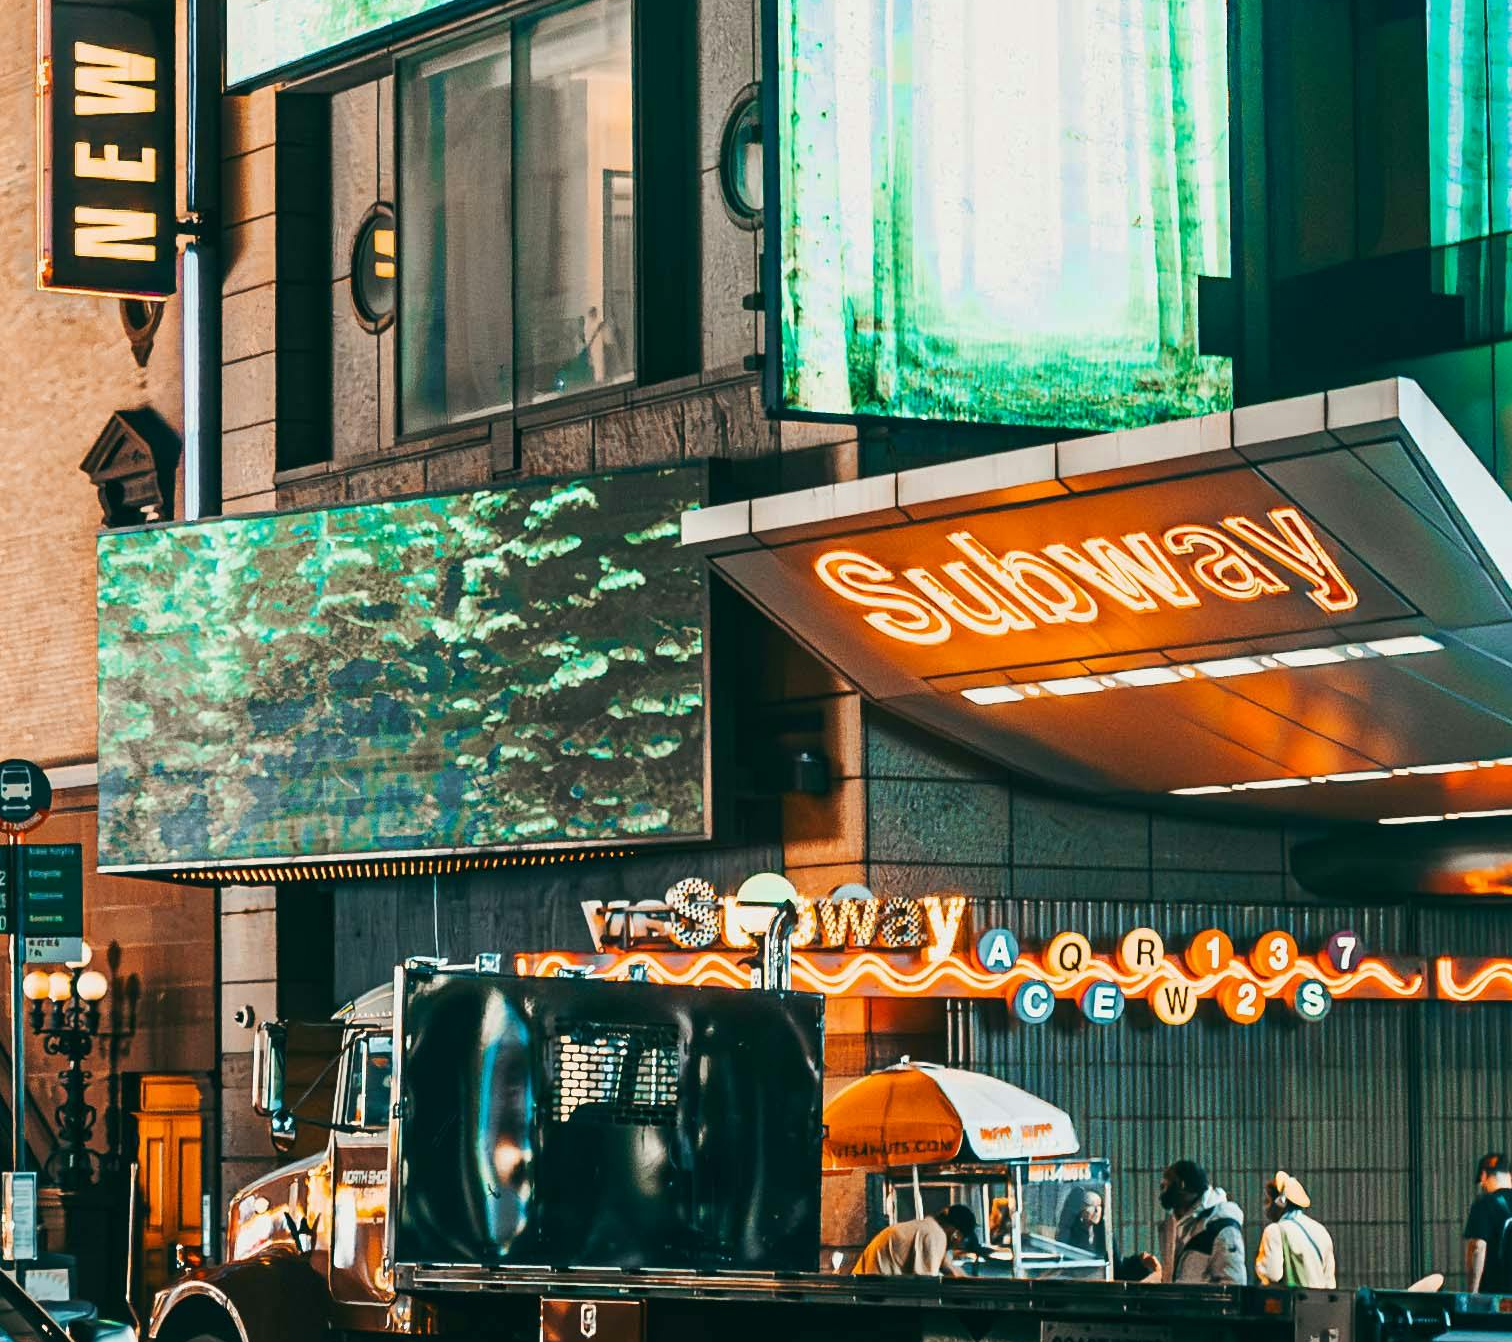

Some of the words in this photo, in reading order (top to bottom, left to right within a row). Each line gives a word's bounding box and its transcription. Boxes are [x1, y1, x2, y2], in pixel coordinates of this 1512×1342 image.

[72, 40, 158, 265] NEW
[815, 505, 1360, 647] Subway
[988, 936, 1012, 968] A
[1059, 943, 1082, 972] Q
[1136, 939, 1155, 966] R
[1206, 937, 1220, 969] 1
[1268, 937, 1289, 969] 3
[1337, 937, 1356, 971] 7
[1022, 984, 1048, 1017] C
[1093, 988, 1117, 1019] E
[1165, 986, 1189, 1016] W
[1237, 987, 1257, 1016] 2
[1302, 983, 1326, 1016] S
